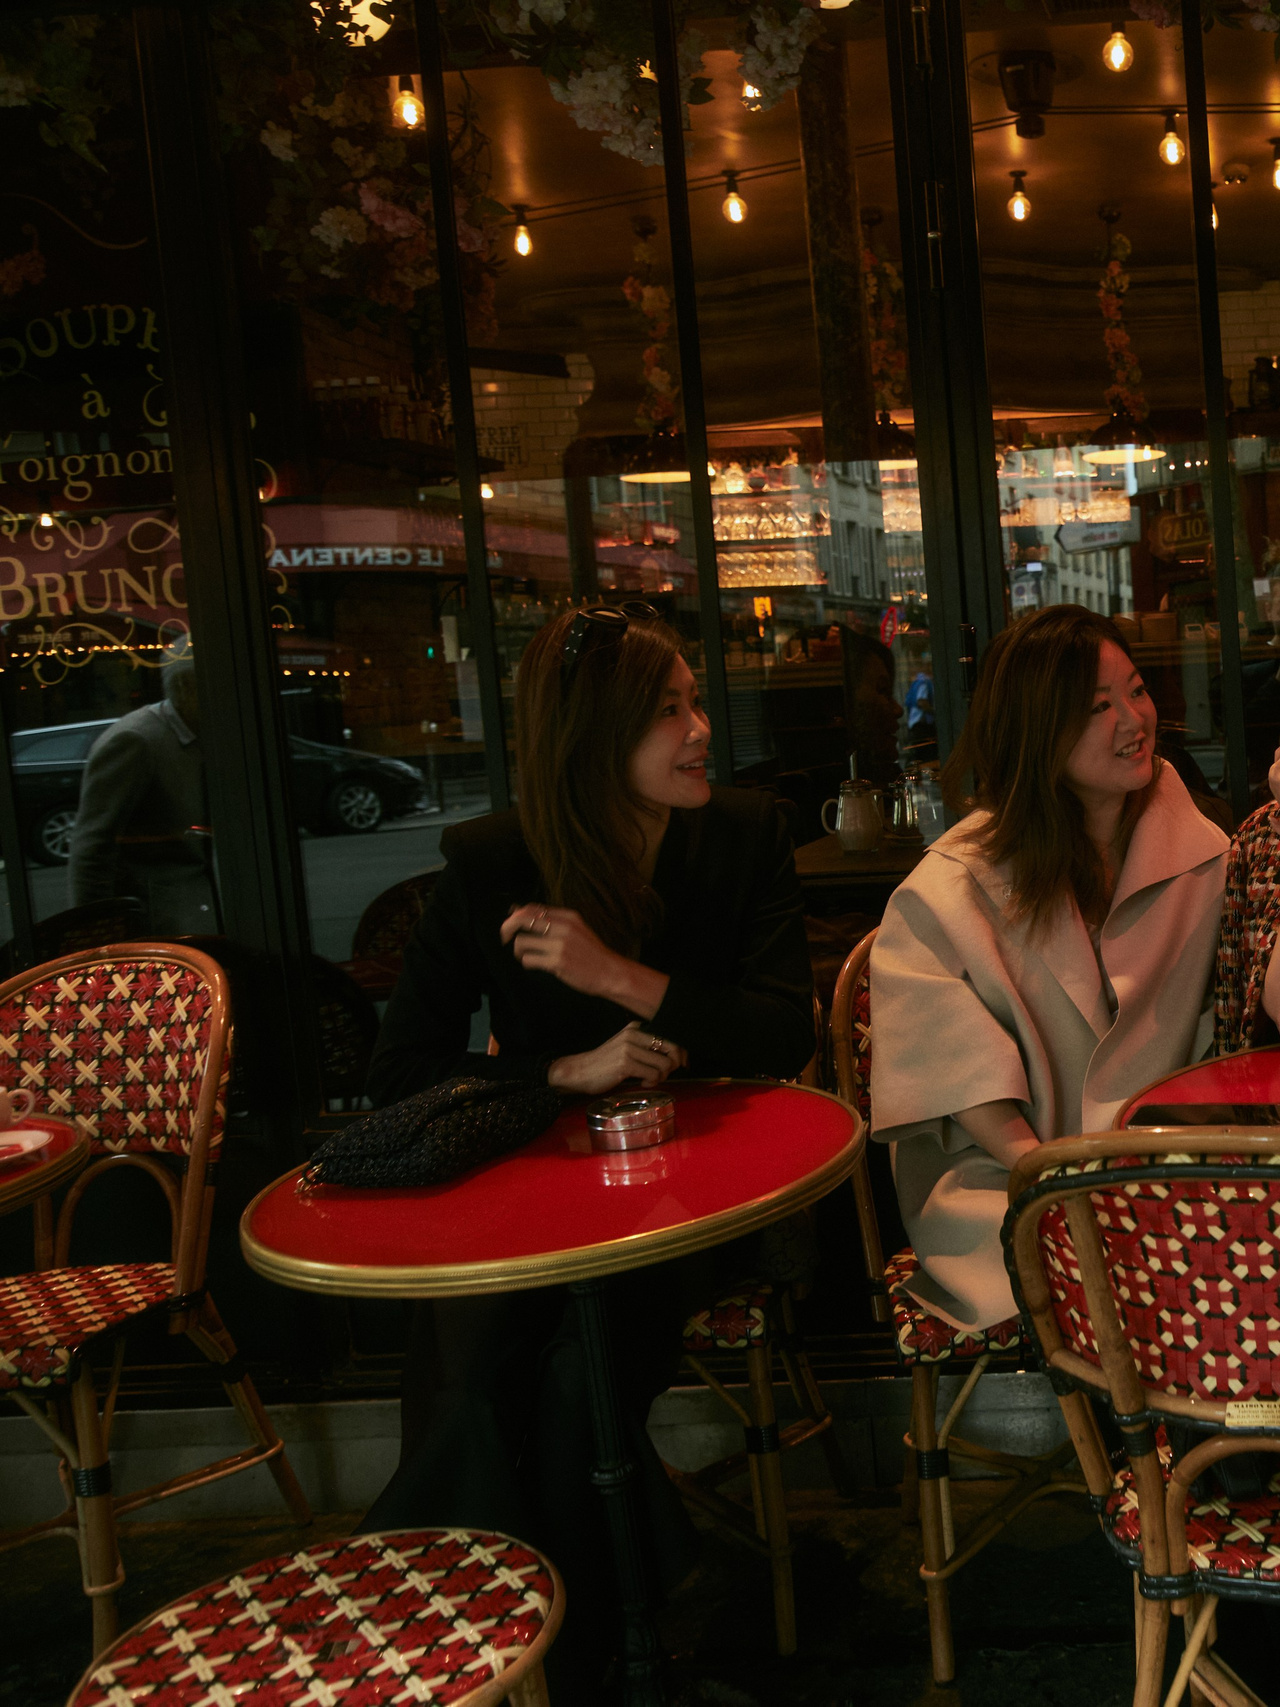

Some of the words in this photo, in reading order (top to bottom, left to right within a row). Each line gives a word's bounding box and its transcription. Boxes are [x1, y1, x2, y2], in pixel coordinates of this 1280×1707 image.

[80, 373, 111, 420] à
[0, 431, 174, 501] 'oignon
[0, 556, 189, 621] BRUNC
